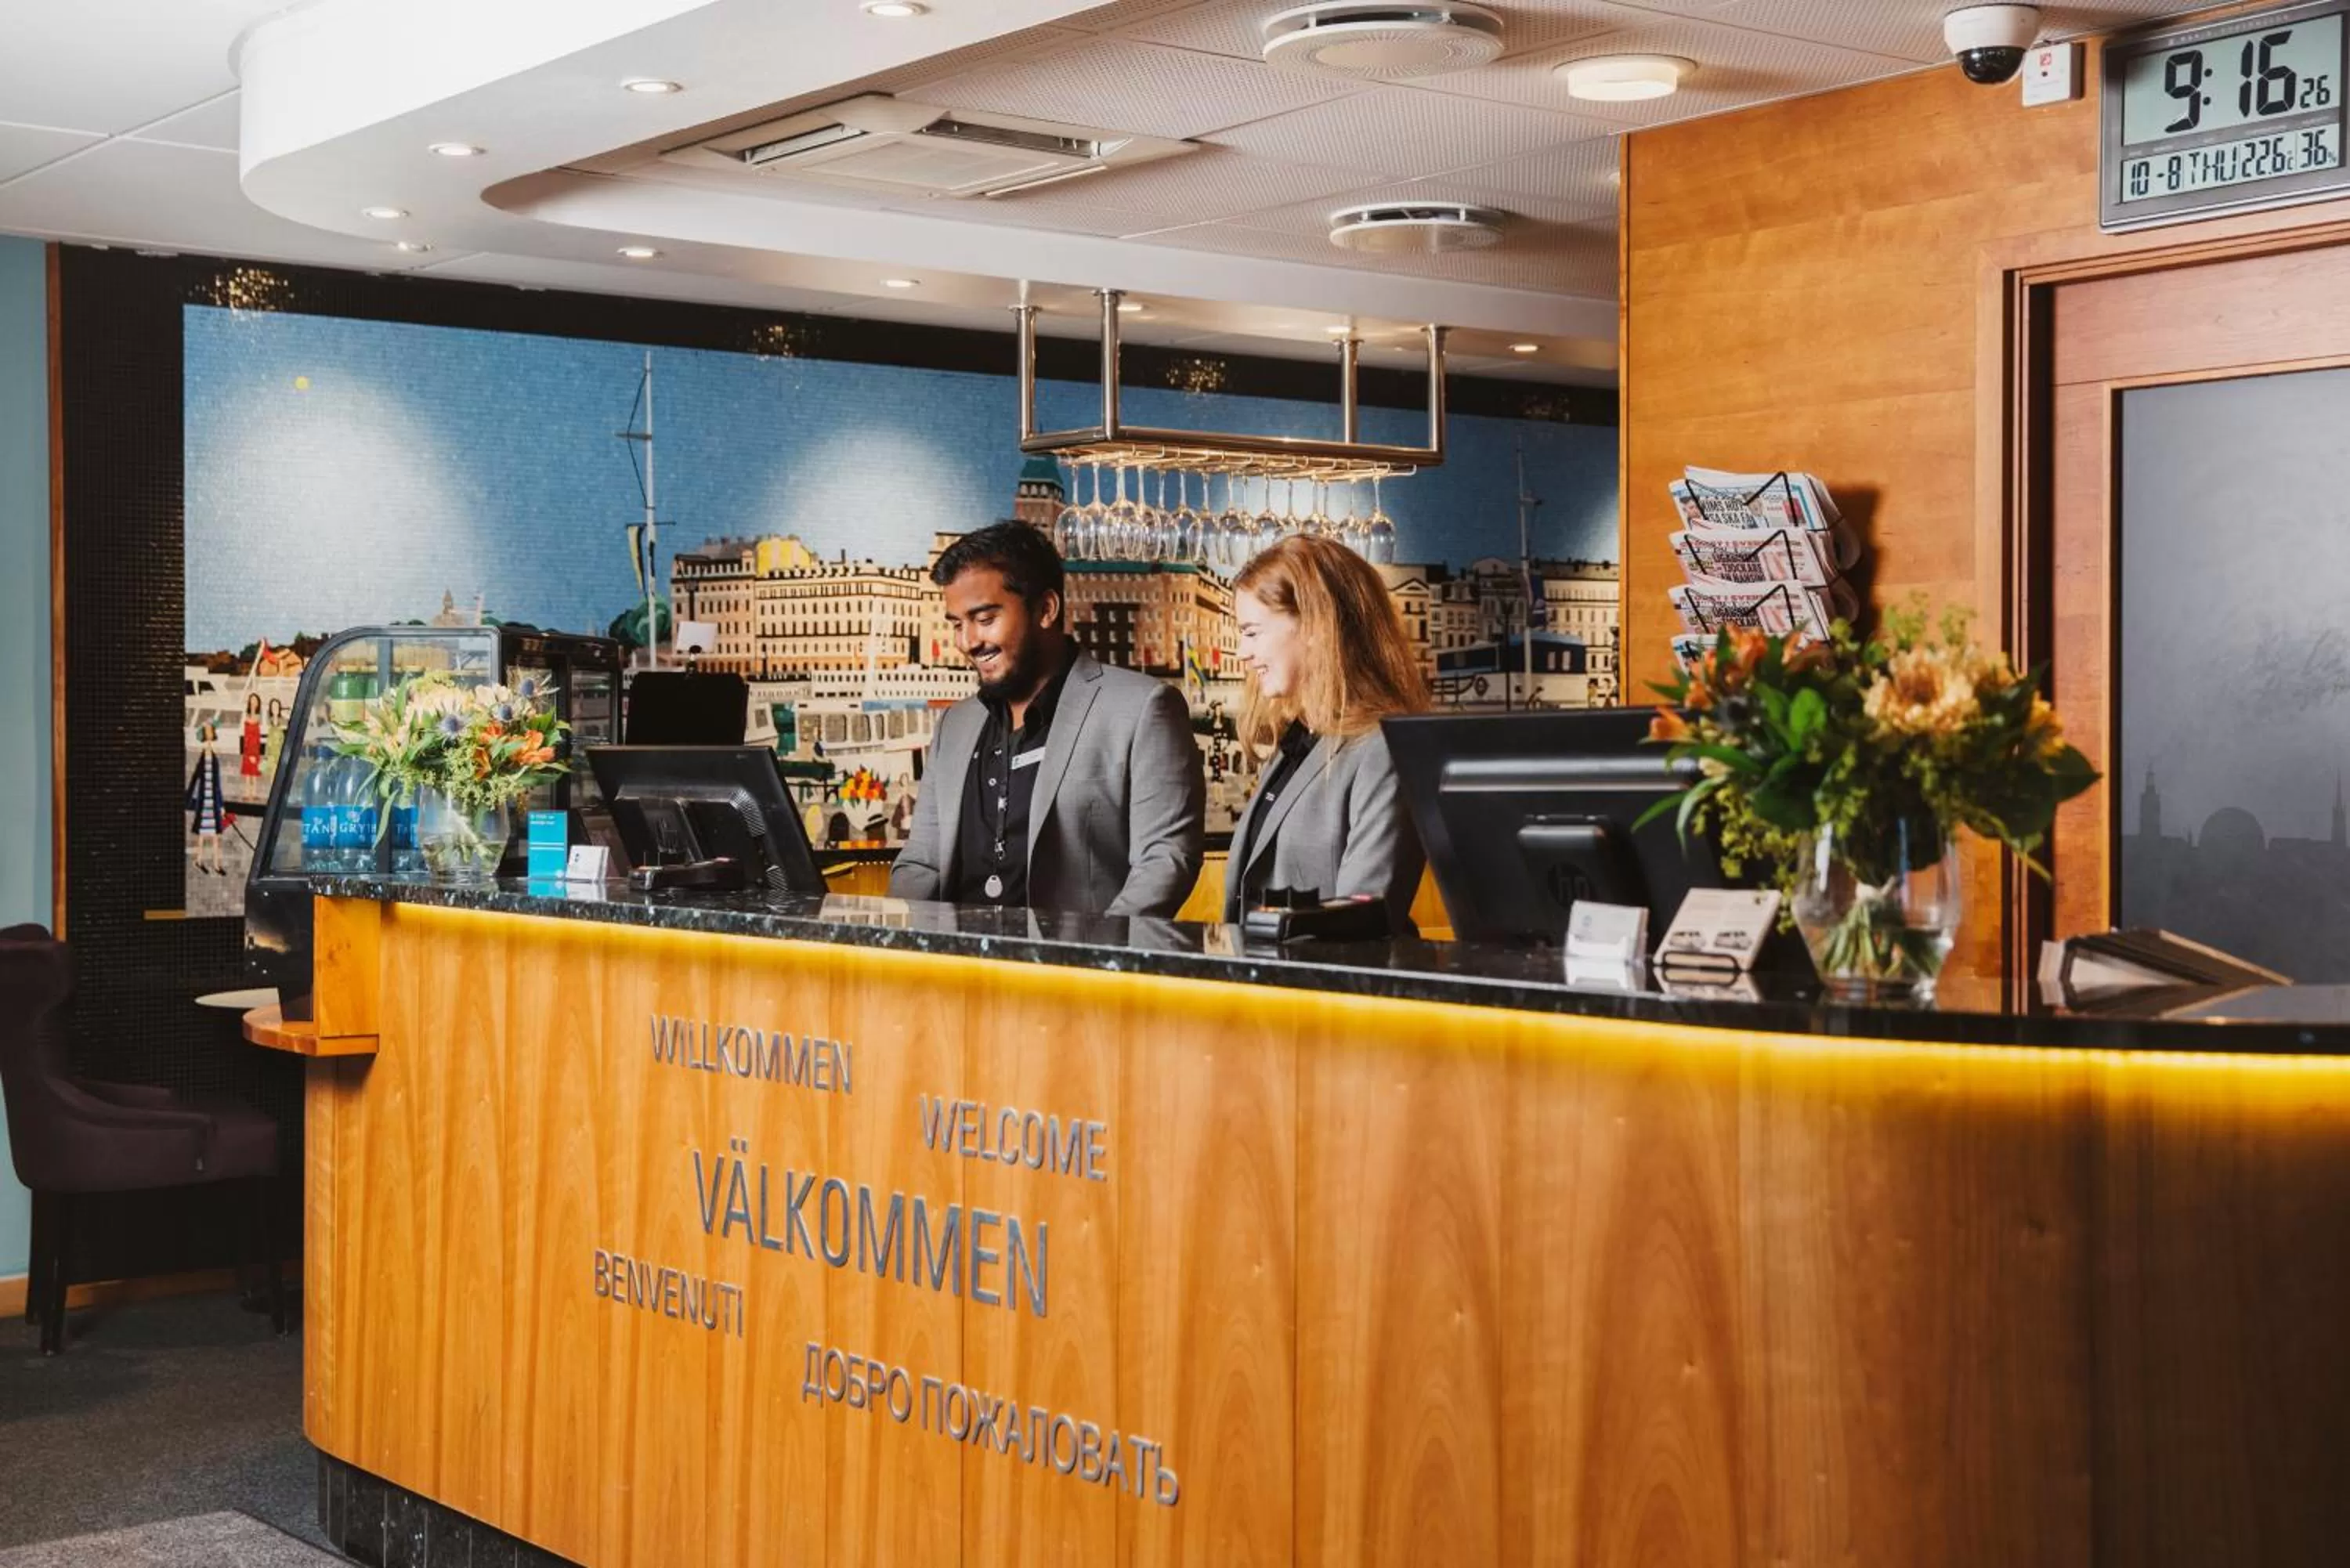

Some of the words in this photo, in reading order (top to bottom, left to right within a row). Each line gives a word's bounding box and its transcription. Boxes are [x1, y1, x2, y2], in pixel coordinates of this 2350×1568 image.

[2165, 30, 2297, 132] 9:16
[2300, 74, 2330, 108] 26
[2189, 146, 2237, 184] THU
[650, 1014, 852, 1095] WILLKOMMEN
[920, 1093, 1107, 1181] WELCOME
[692, 1136, 1048, 1317] VÄLKOMMEN
[595, 1247, 743, 1338] BENVENUTI
[802, 1341, 912, 1423] ДОБРО
[920, 1375, 1179, 1506] ПОЖАЛОВАТЬ
